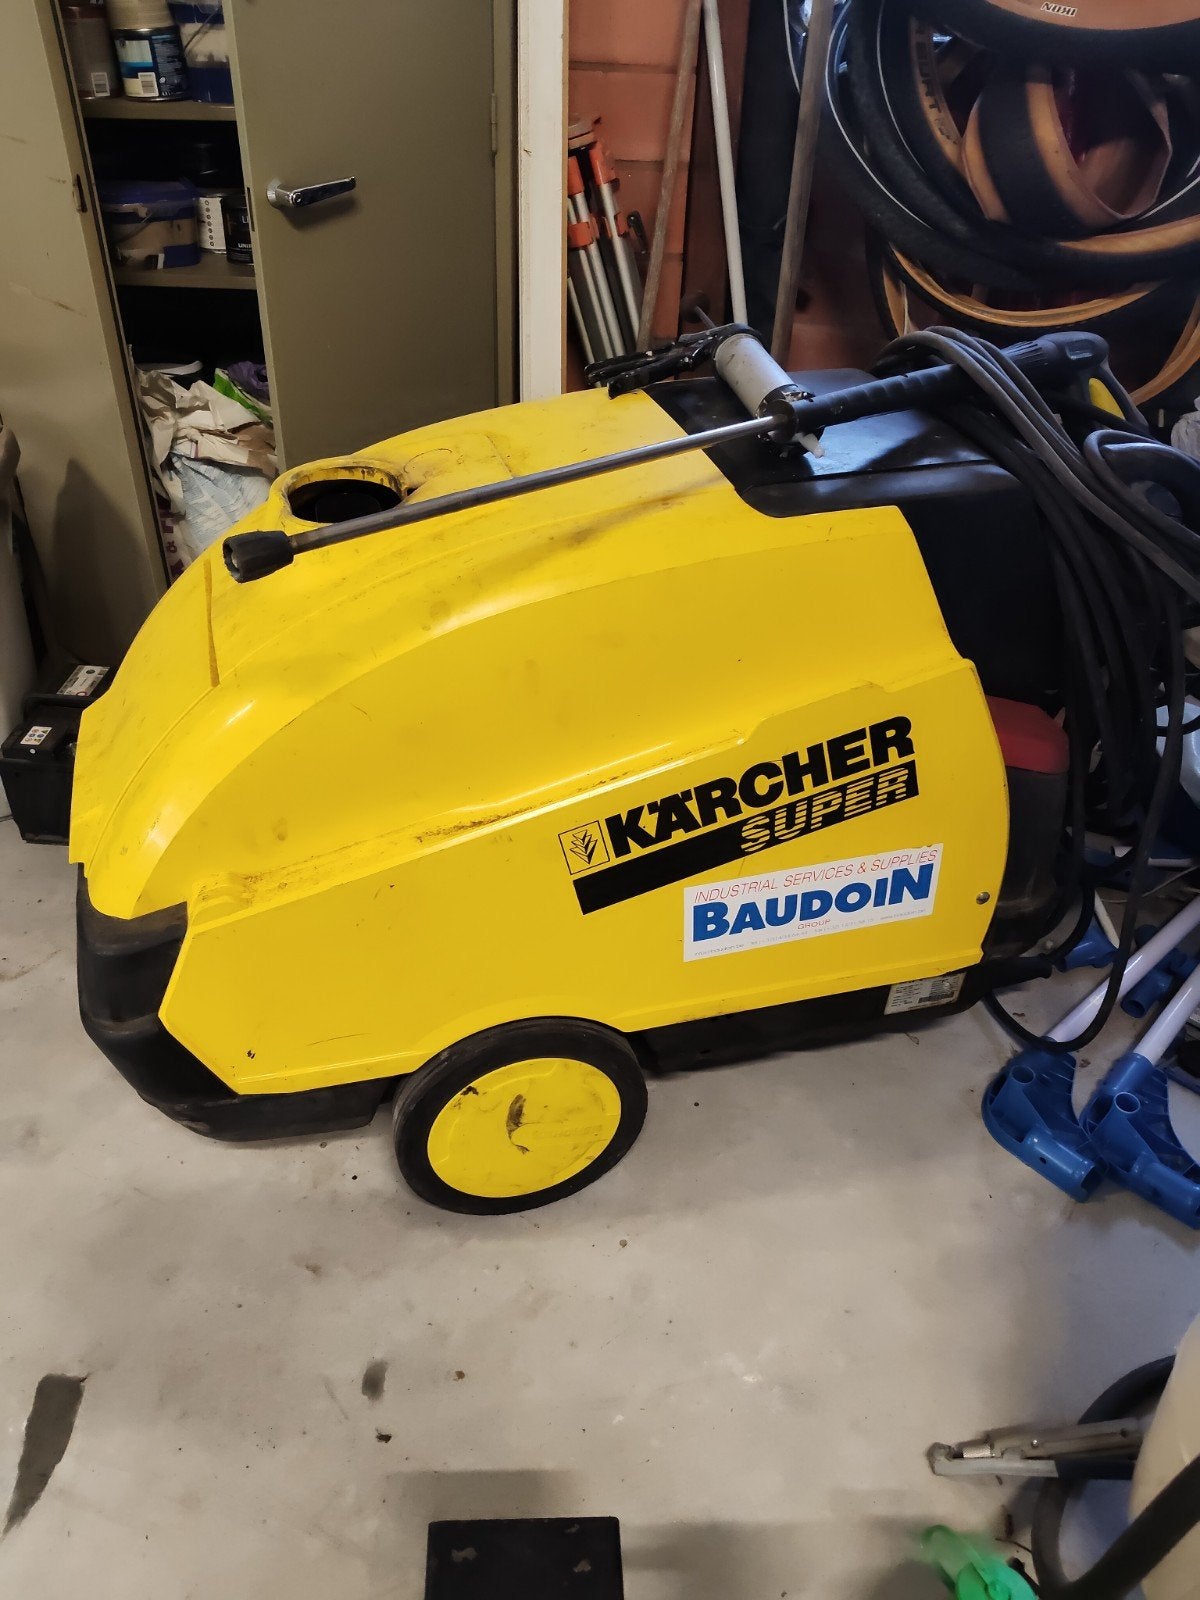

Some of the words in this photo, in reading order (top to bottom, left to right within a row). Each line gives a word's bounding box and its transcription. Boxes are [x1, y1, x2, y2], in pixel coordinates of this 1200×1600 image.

[605, 716, 915, 858] KÄRCHER
[741, 767, 909, 852] SUPER
[692, 863, 934, 942] BAUDOIN
[694, 878, 778, 903] INDUSTRIAL
[783, 863, 853, 888] SERVICES
[857, 861, 866, 875] &
[870, 849, 938, 872] SUPPLIES
[797, 919, 831, 930] GROUP
